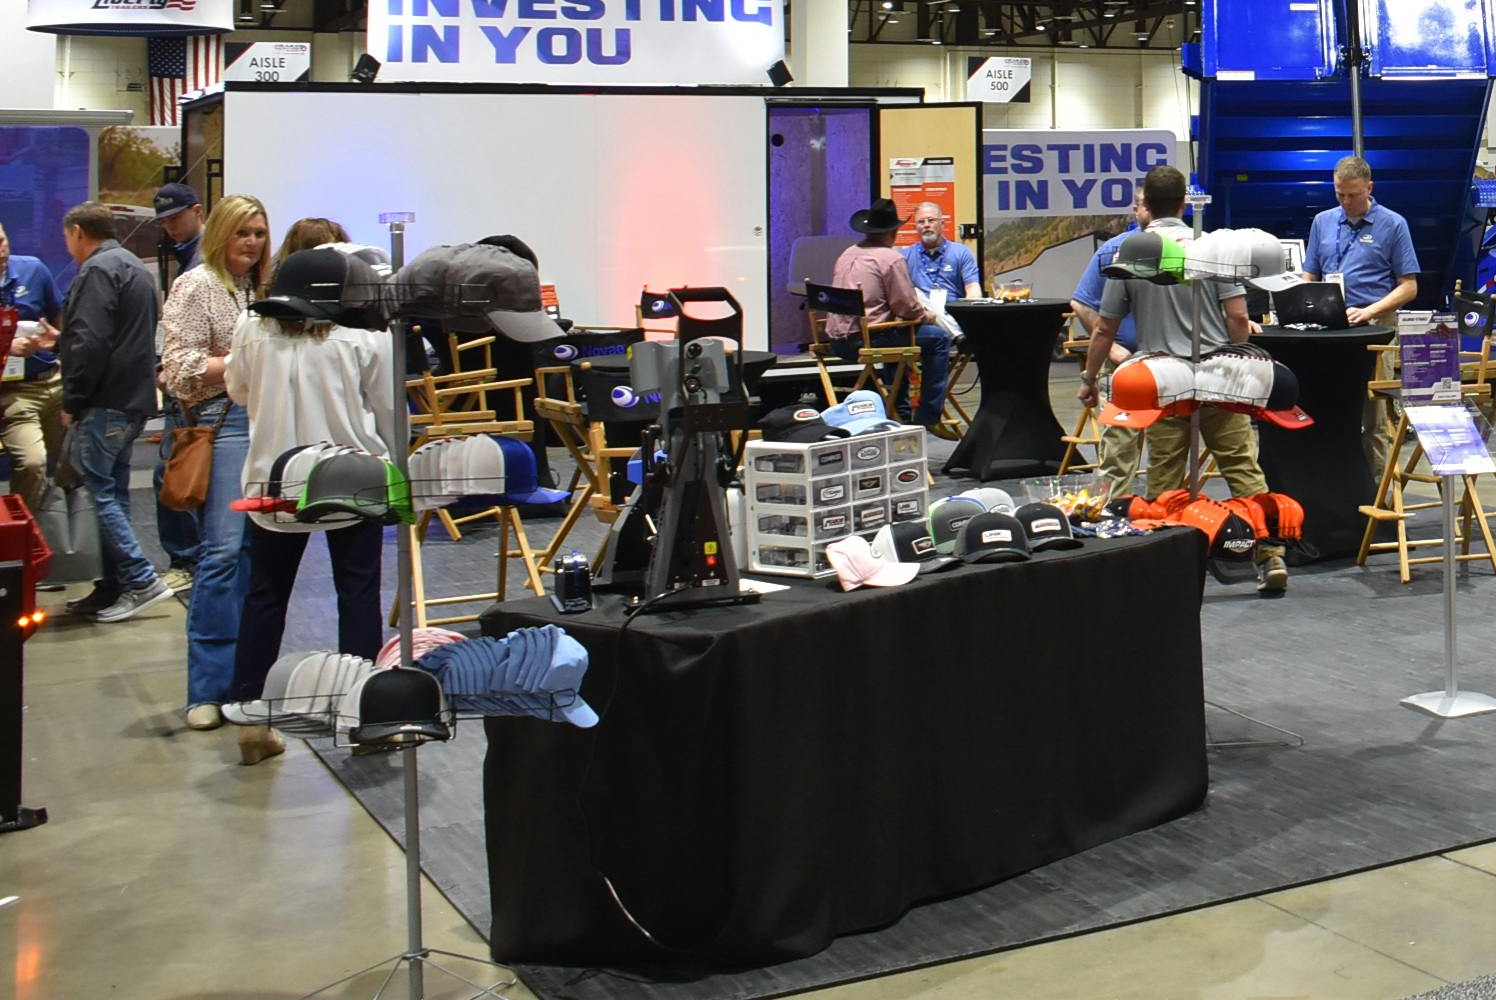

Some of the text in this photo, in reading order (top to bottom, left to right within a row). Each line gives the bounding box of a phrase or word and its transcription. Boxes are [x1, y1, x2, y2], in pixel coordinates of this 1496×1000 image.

[387, 23, 632, 66] IN YOU
[249, 57, 286, 68] AISLE
[255, 70, 280, 81] 300
[985, 69, 1014, 80] AISLE
[990, 80, 1009, 91] 500
[998, 180, 1049, 211] IN
